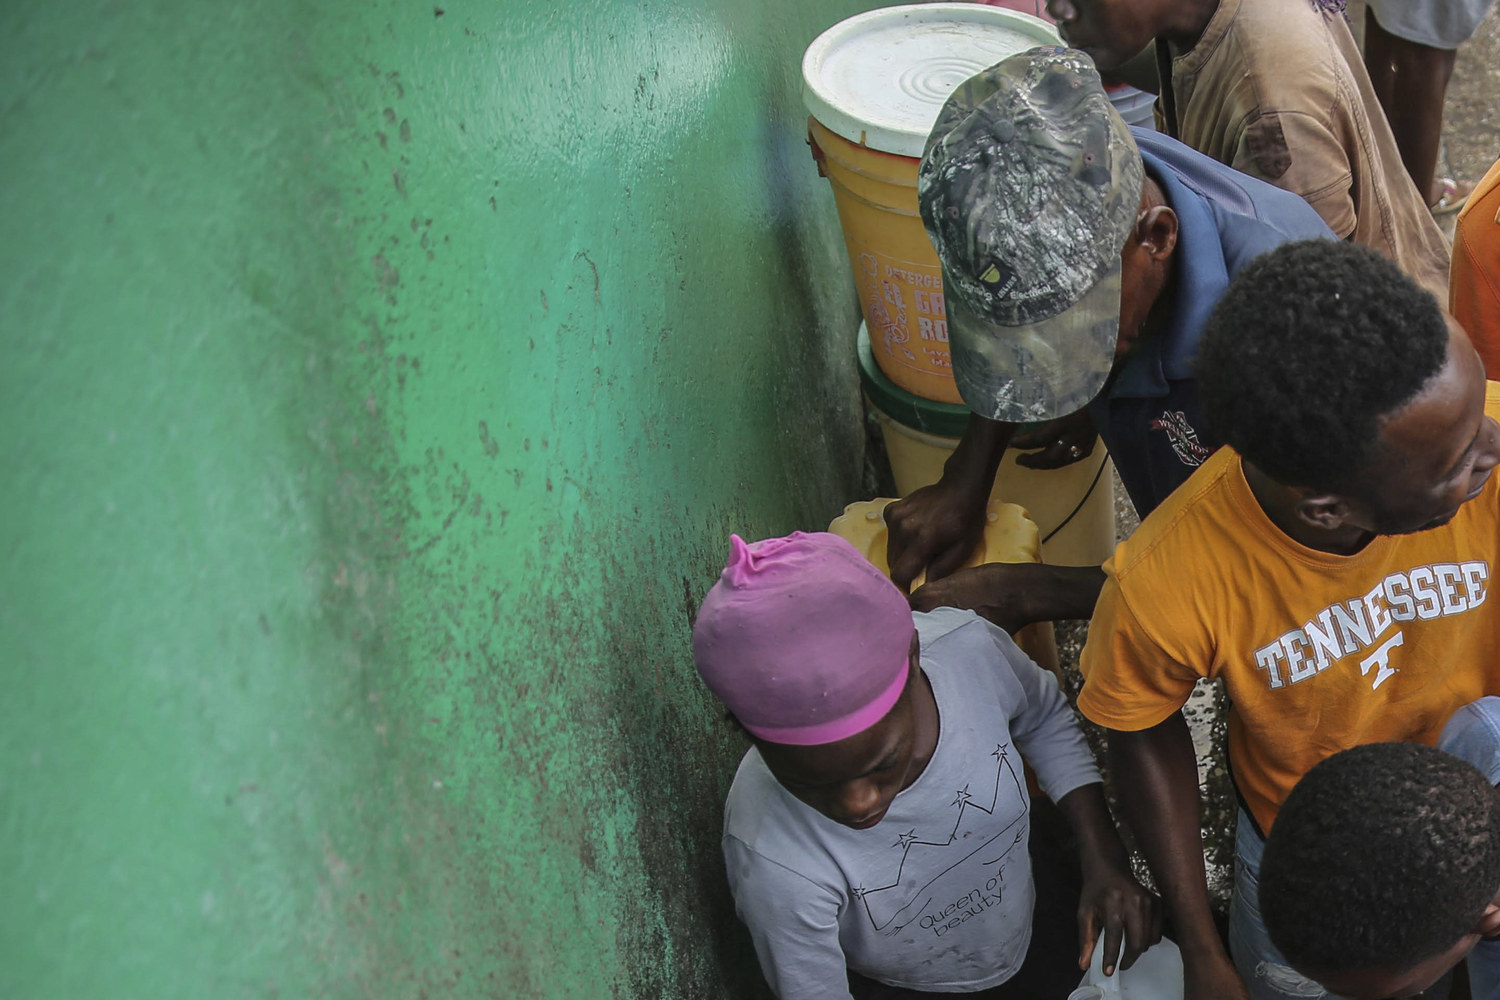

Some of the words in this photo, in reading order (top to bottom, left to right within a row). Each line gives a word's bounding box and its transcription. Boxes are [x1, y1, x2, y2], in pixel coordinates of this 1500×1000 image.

[884, 264, 944, 289] DETERGE
[1253, 560, 1490, 690] TENNESSEE
[919, 887, 982, 930] Queen
[985, 864, 1006, 891] of
[933, 887, 1003, 937] beauty
